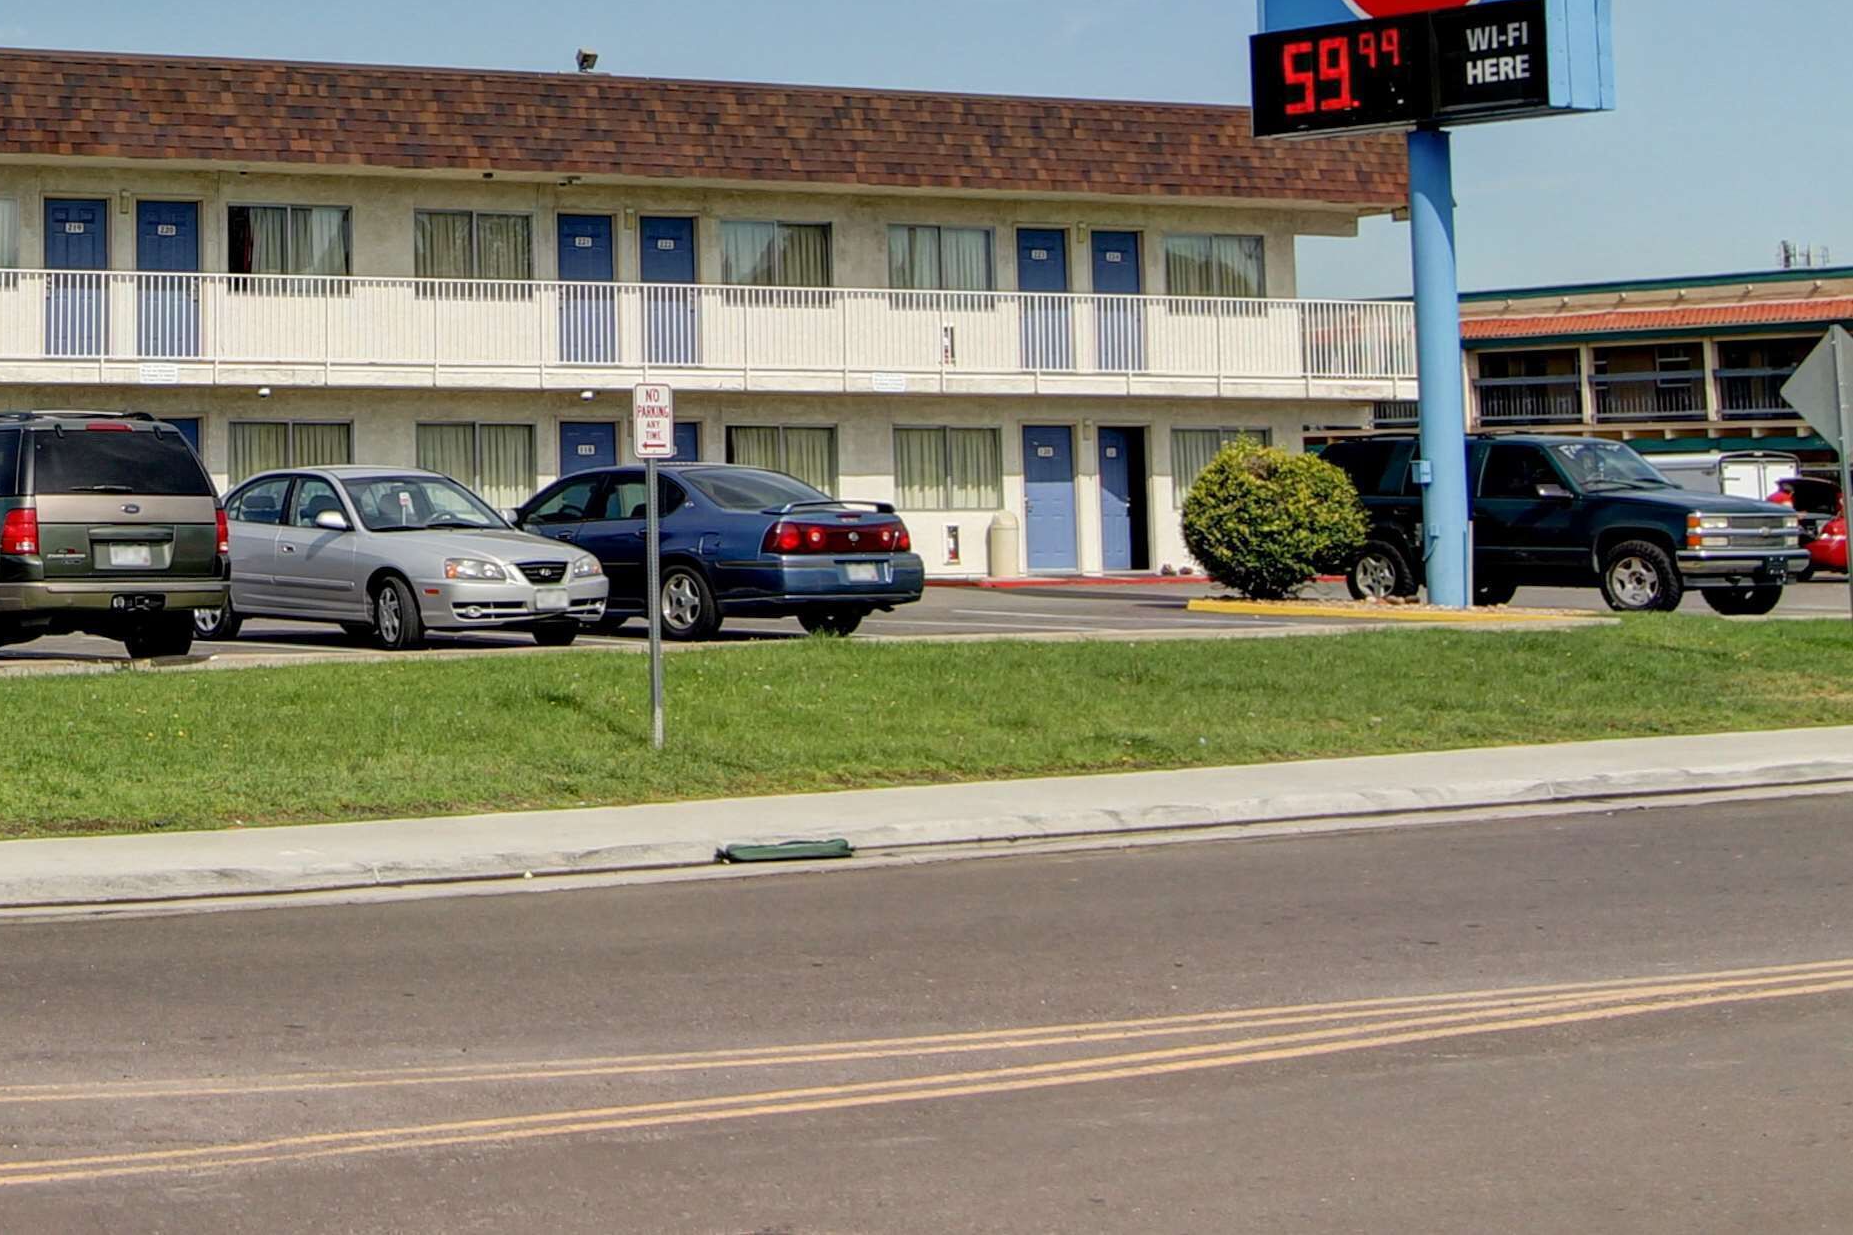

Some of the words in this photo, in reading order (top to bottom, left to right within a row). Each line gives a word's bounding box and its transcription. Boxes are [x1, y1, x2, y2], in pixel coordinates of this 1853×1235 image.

[1465, 20, 1529, 53] WI-FI
[1466, 54, 1531, 85] HERE
[645, 388, 660, 402] NO
[637, 405, 669, 418] PARKING
[646, 420, 660, 428] ANY
[645, 430, 661, 440] TIME
